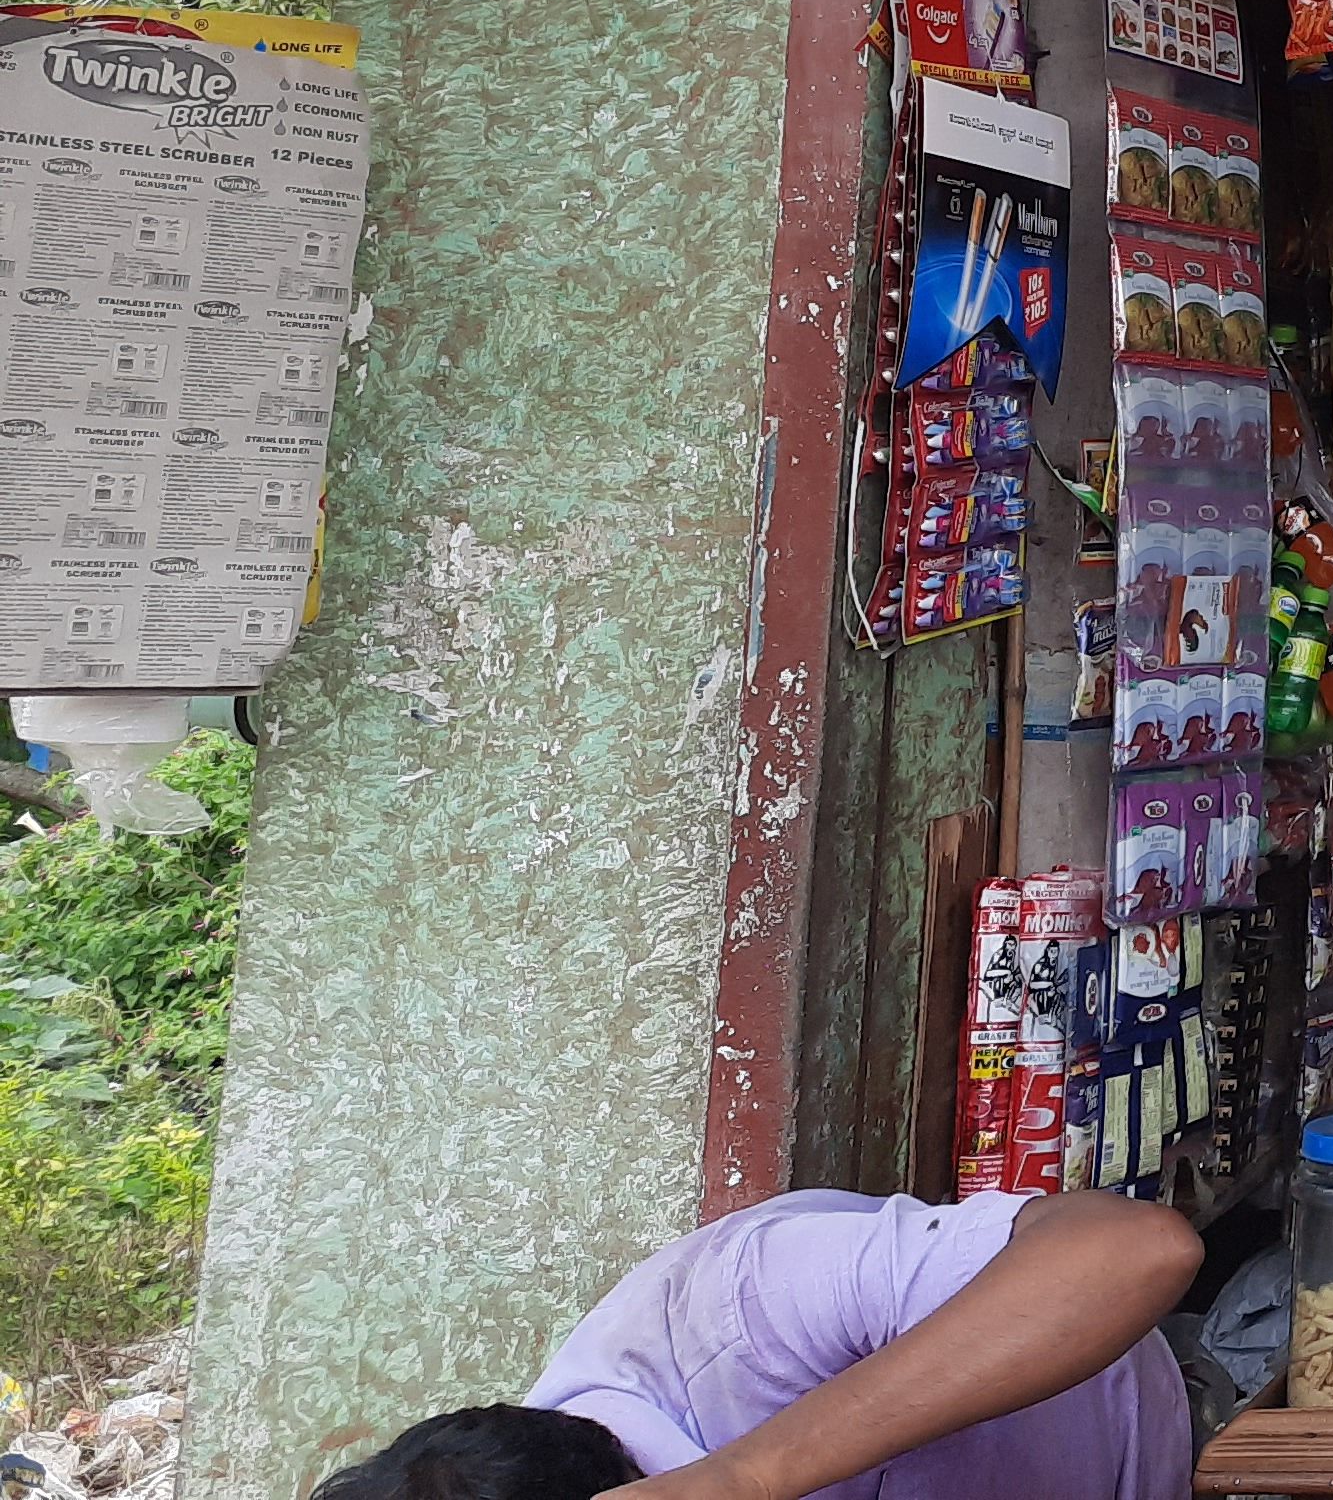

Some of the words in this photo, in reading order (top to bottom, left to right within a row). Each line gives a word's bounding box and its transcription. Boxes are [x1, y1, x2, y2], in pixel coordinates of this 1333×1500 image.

[916, 3, 959, 26] Colgate
[271, 42, 310, 53] LONG
[314, 43, 344, 54] LIFE
[45, 47, 233, 103] Twinkle
[295, 82, 330, 96] LONG
[334, 86, 359, 101] LIFE
[167, 104, 272, 128] BRIGHT
[294, 103, 366, 123] ECONOMIC
[292, 125, 322, 140] NON
[326, 129, 360, 144] RUST
[99, 140, 155, 157] STEEL
[160, 147, 255, 168] SCRUBBER
[271, 148, 291, 162] 12
[297, 151, 354, 170] Pieces
